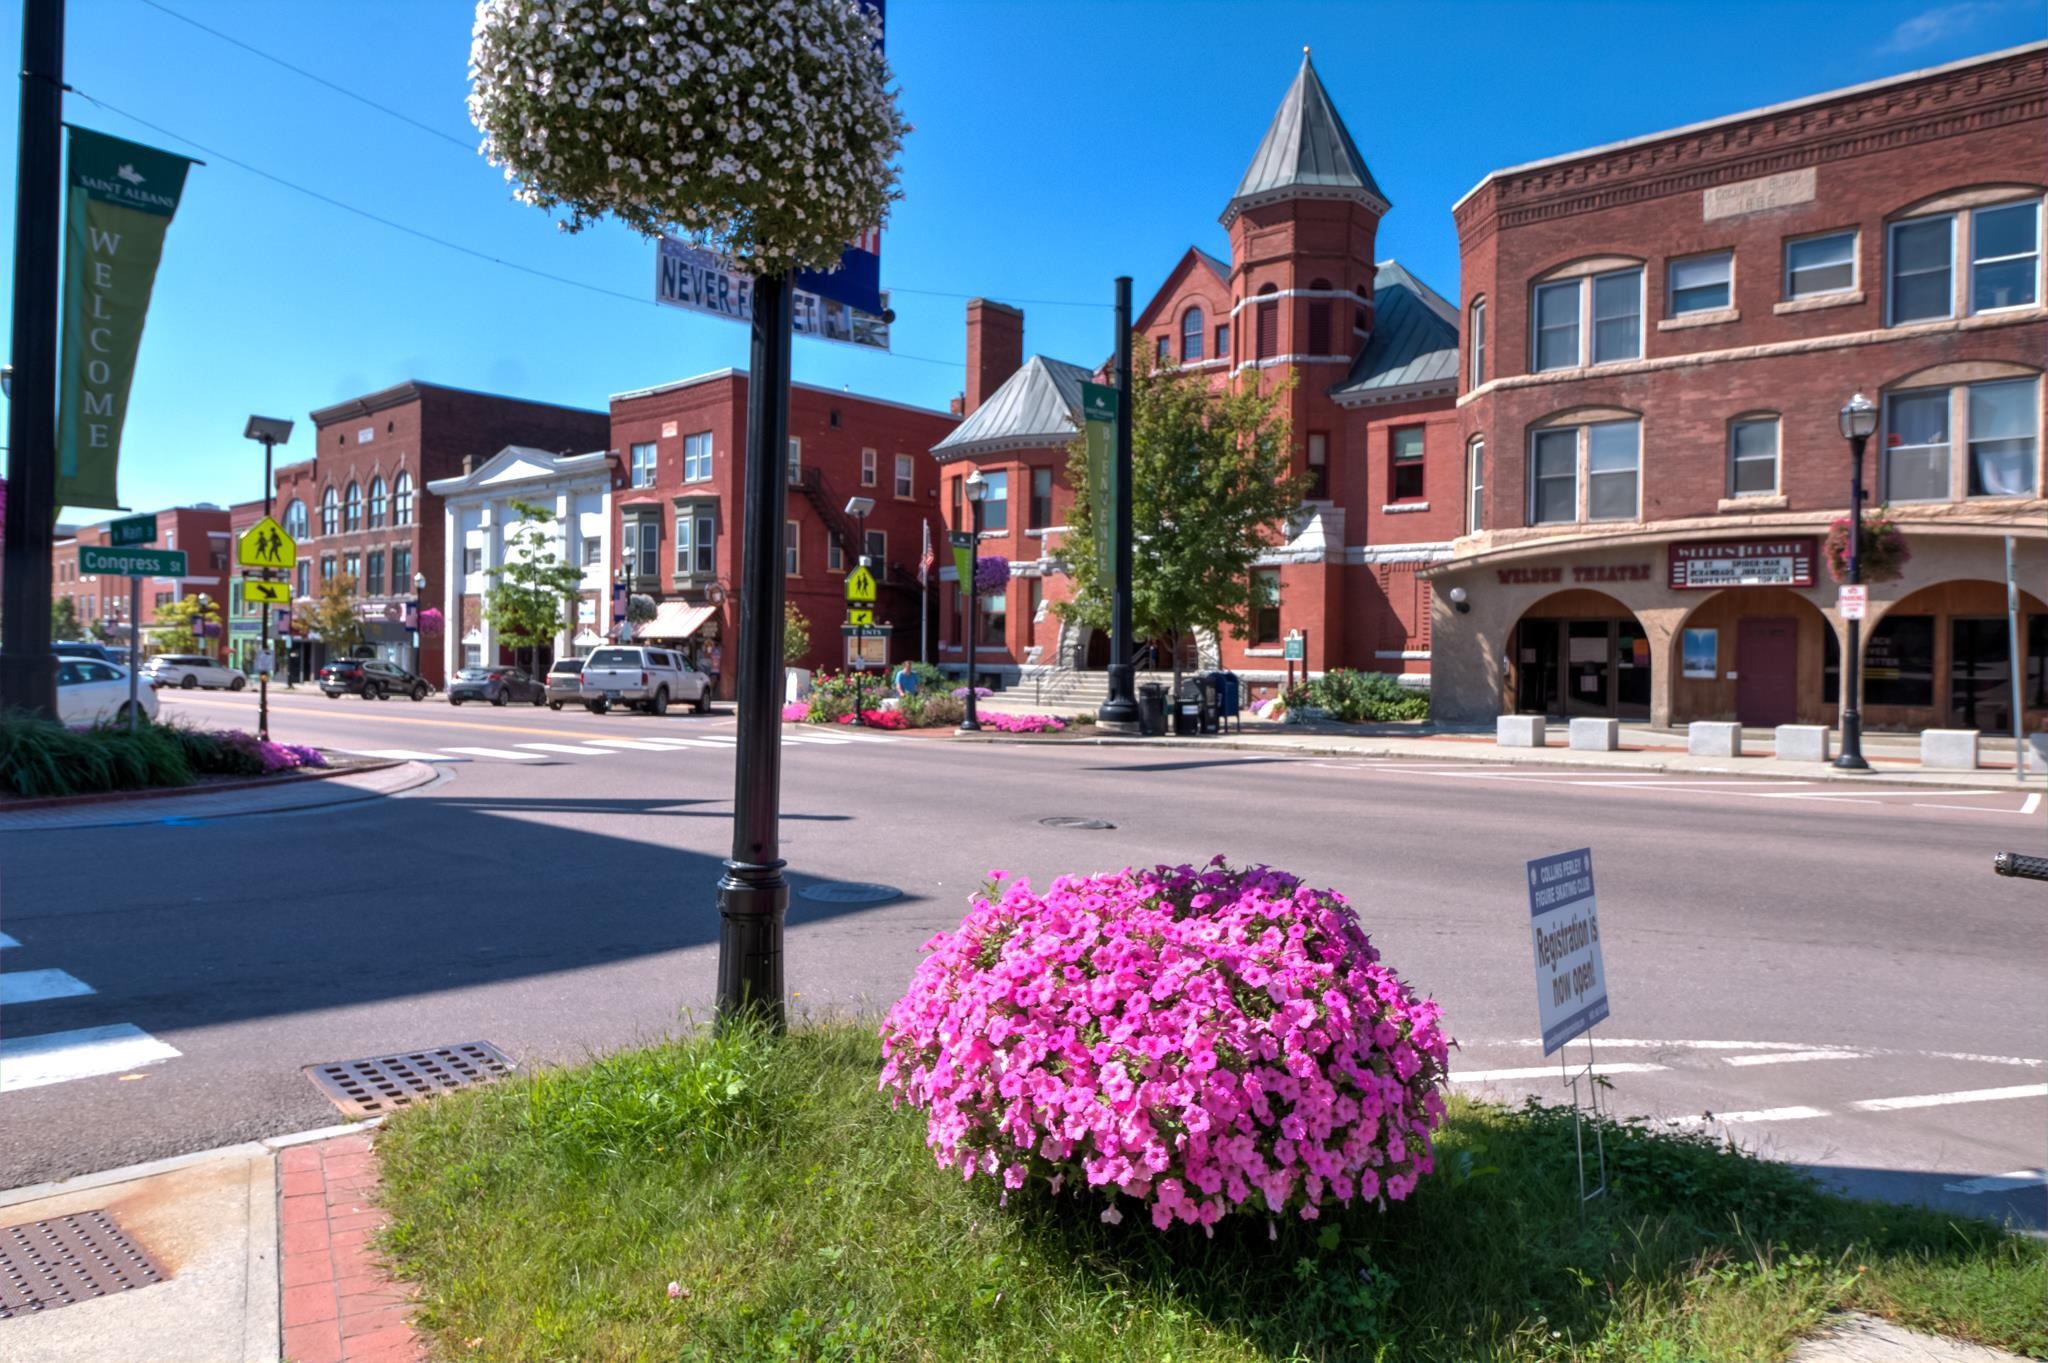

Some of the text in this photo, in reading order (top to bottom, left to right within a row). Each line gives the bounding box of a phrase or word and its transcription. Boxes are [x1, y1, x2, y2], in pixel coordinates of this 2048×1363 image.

[80, 175, 121, 195] SAINT
[124, 188, 175, 208] ALBANS
[663, 258, 732, 314] NEVER
[83, 226, 122, 448] WELCOME
[85, 551, 181, 576] Congress St
[1497, 564, 1651, 584] WELDEN THEATRE
[1732, 559, 1780, 567] SPIDER-MAN
[1535, 886, 1555, 908] FIGURE
[1536, 907, 1599, 973] Registration is
[1552, 971, 1571, 1008] now
